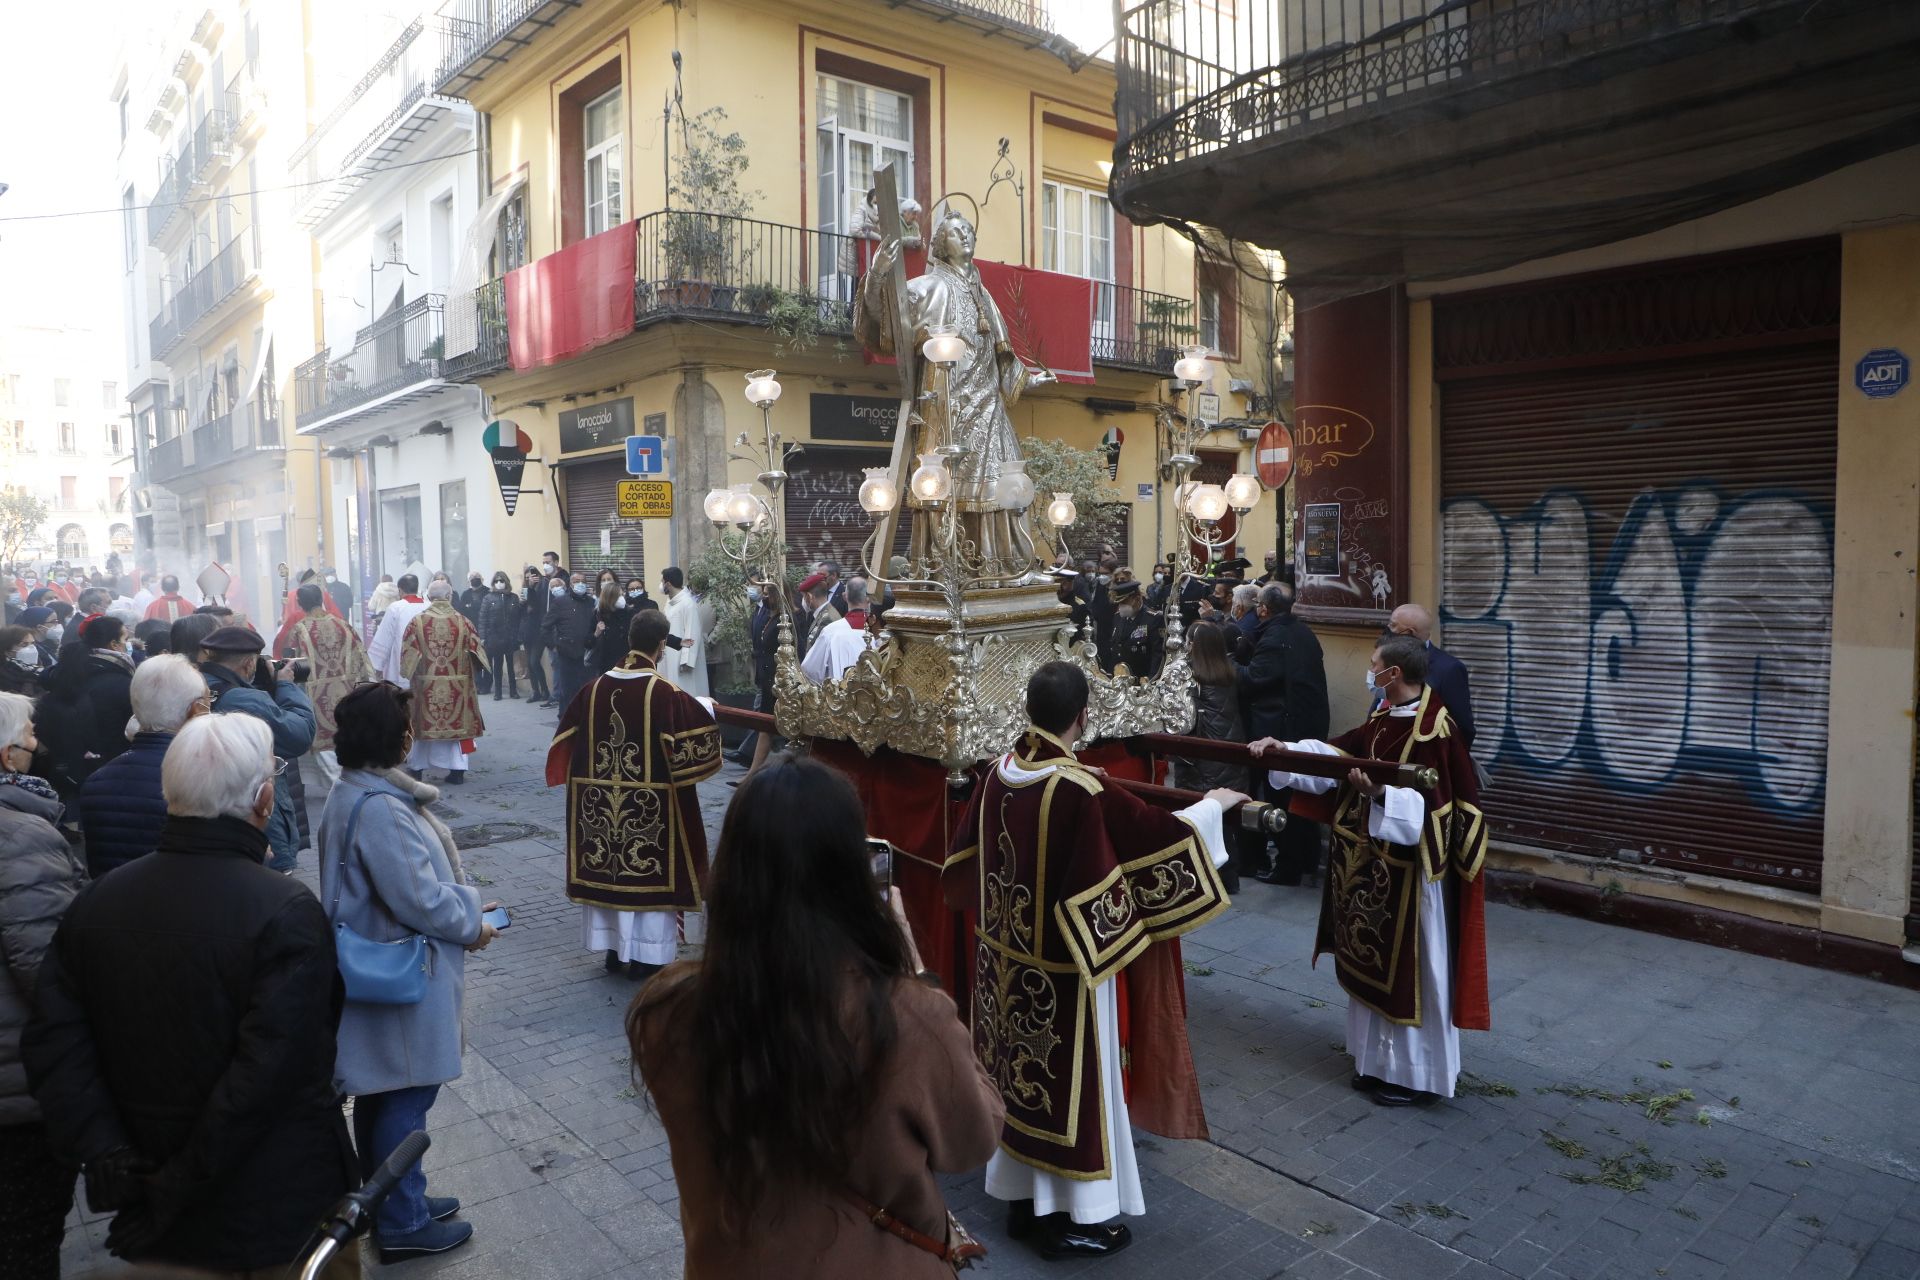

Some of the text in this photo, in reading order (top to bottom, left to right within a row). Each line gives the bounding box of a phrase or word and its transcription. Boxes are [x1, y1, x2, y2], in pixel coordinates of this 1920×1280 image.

[1863, 364, 1901, 383] ADT
[851, 400, 900, 419] lanocci
[577, 407, 612, 429] lanocciola
[628, 483, 663, 492] ACCESO
[625, 492, 666, 501] CORTADO
[620, 501, 671, 510] POR OBRAS
